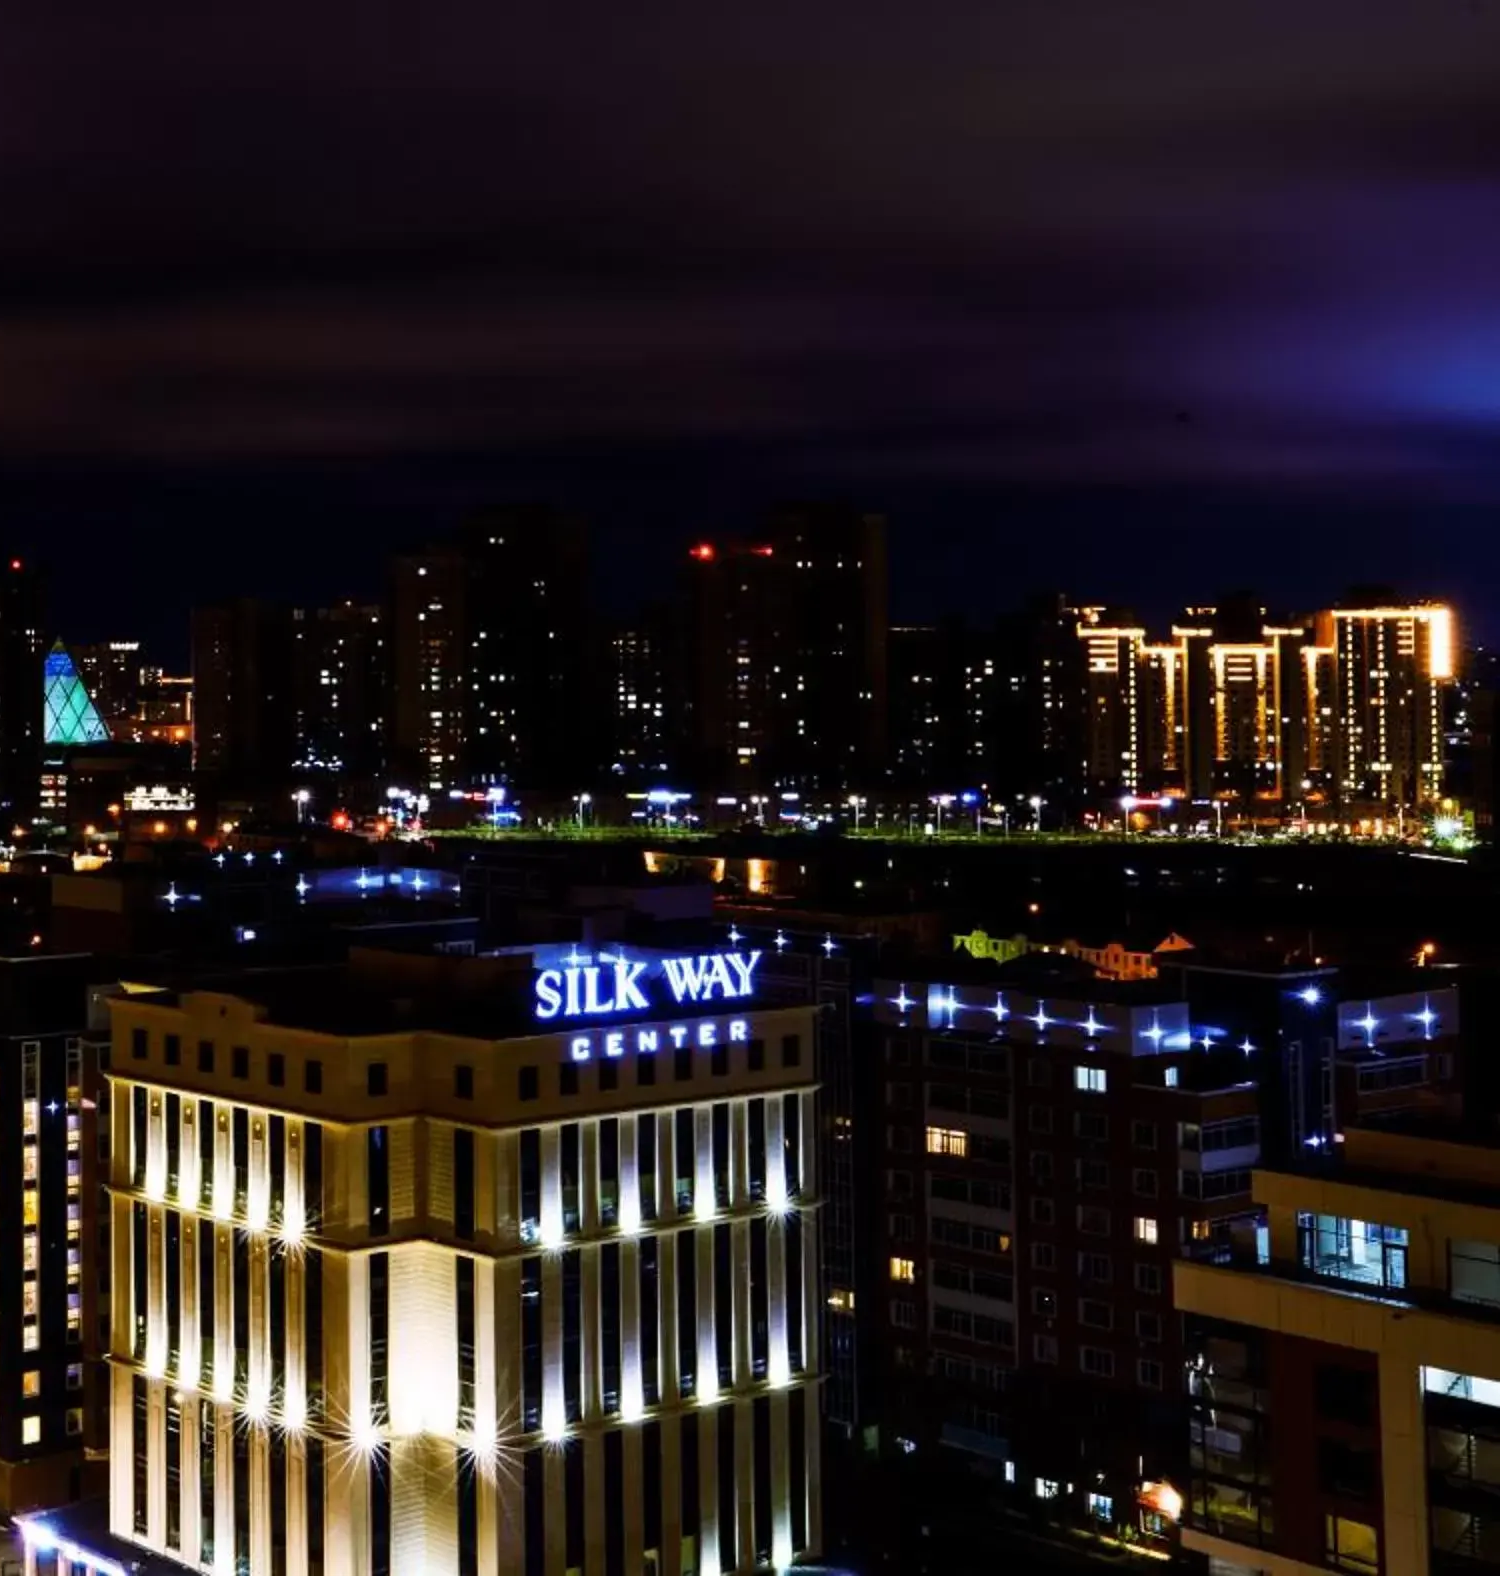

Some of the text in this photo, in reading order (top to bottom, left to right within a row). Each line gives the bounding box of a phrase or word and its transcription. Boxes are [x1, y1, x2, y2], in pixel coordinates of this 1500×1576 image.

[534, 950, 761, 1018] SILK WAY
[571, 1019, 747, 1061] CENTER
